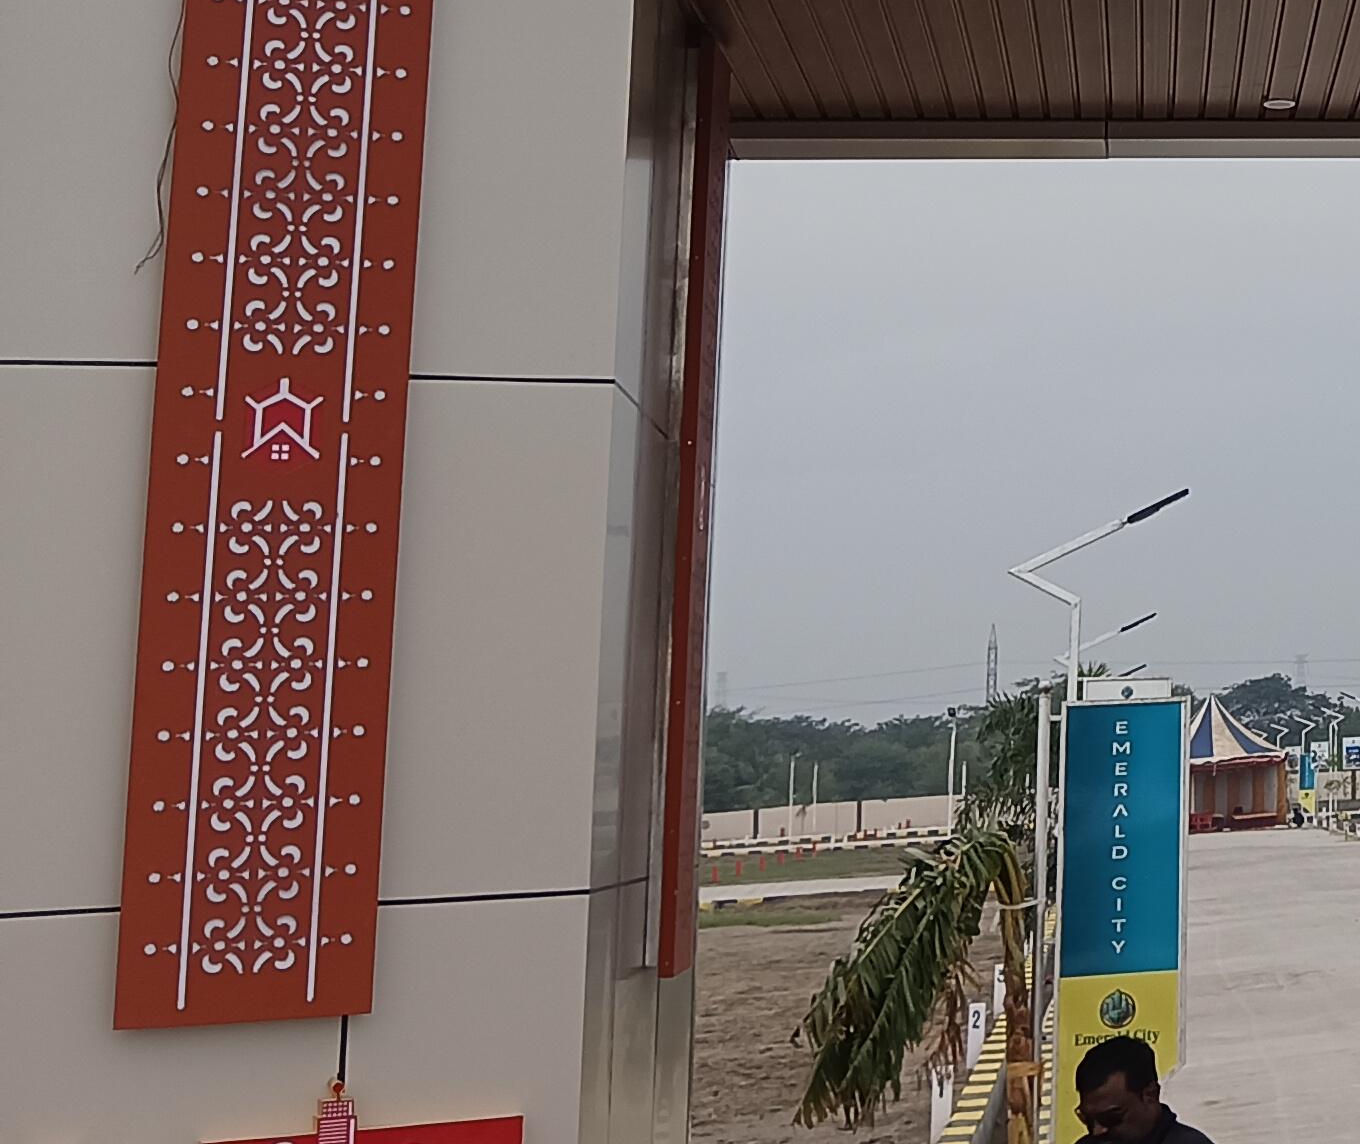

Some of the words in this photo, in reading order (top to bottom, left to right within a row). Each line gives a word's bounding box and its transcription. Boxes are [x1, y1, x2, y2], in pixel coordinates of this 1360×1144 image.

[1112, 721, 1131, 860] EMERALD
[1111, 876, 1127, 954] CITY
[972, 1009, 981, 1029] 2
